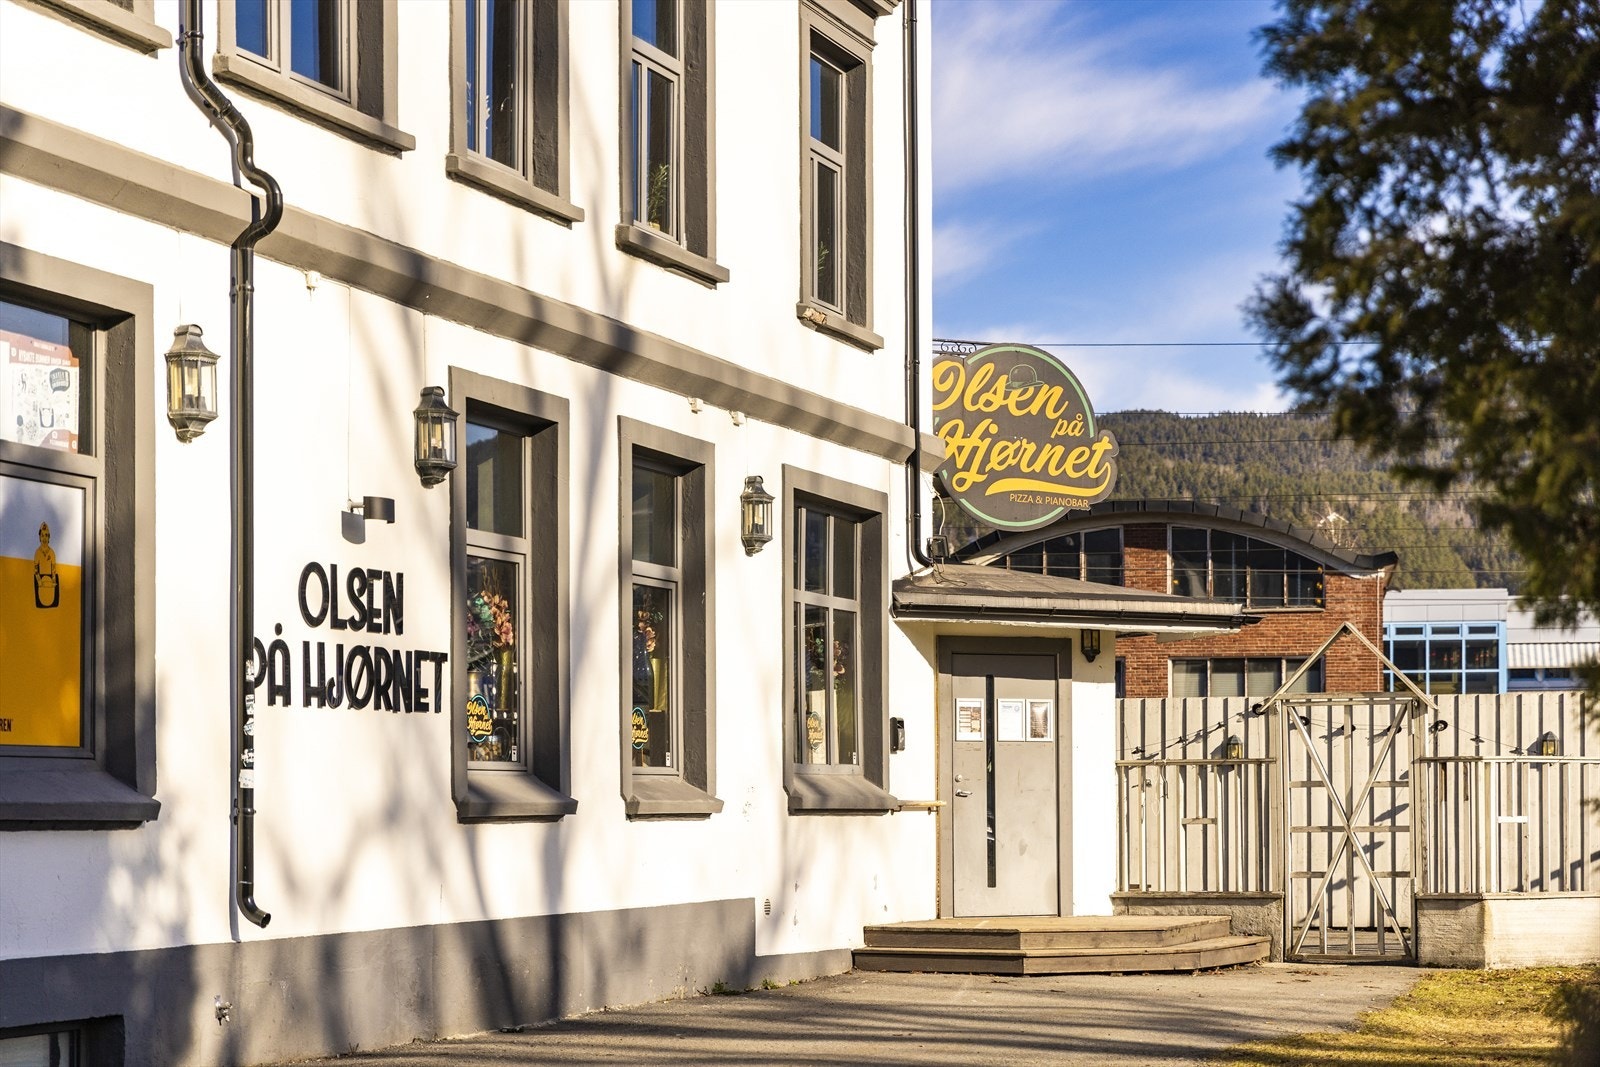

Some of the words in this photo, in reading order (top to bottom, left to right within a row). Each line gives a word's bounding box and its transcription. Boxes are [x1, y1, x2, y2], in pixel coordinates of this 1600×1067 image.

[933, 360, 1069, 420] Olsen
[937, 419, 1113, 494] Hjørnet
[1051, 413, 1085, 439] på
[1009, 493, 1034, 504] PIZZA
[1036, 495, 1043, 505] &
[1045, 496, 1089, 508] PIANOBAR
[298, 561, 404, 636] OLSEN
[302, 640, 448, 714] HJØRNET
